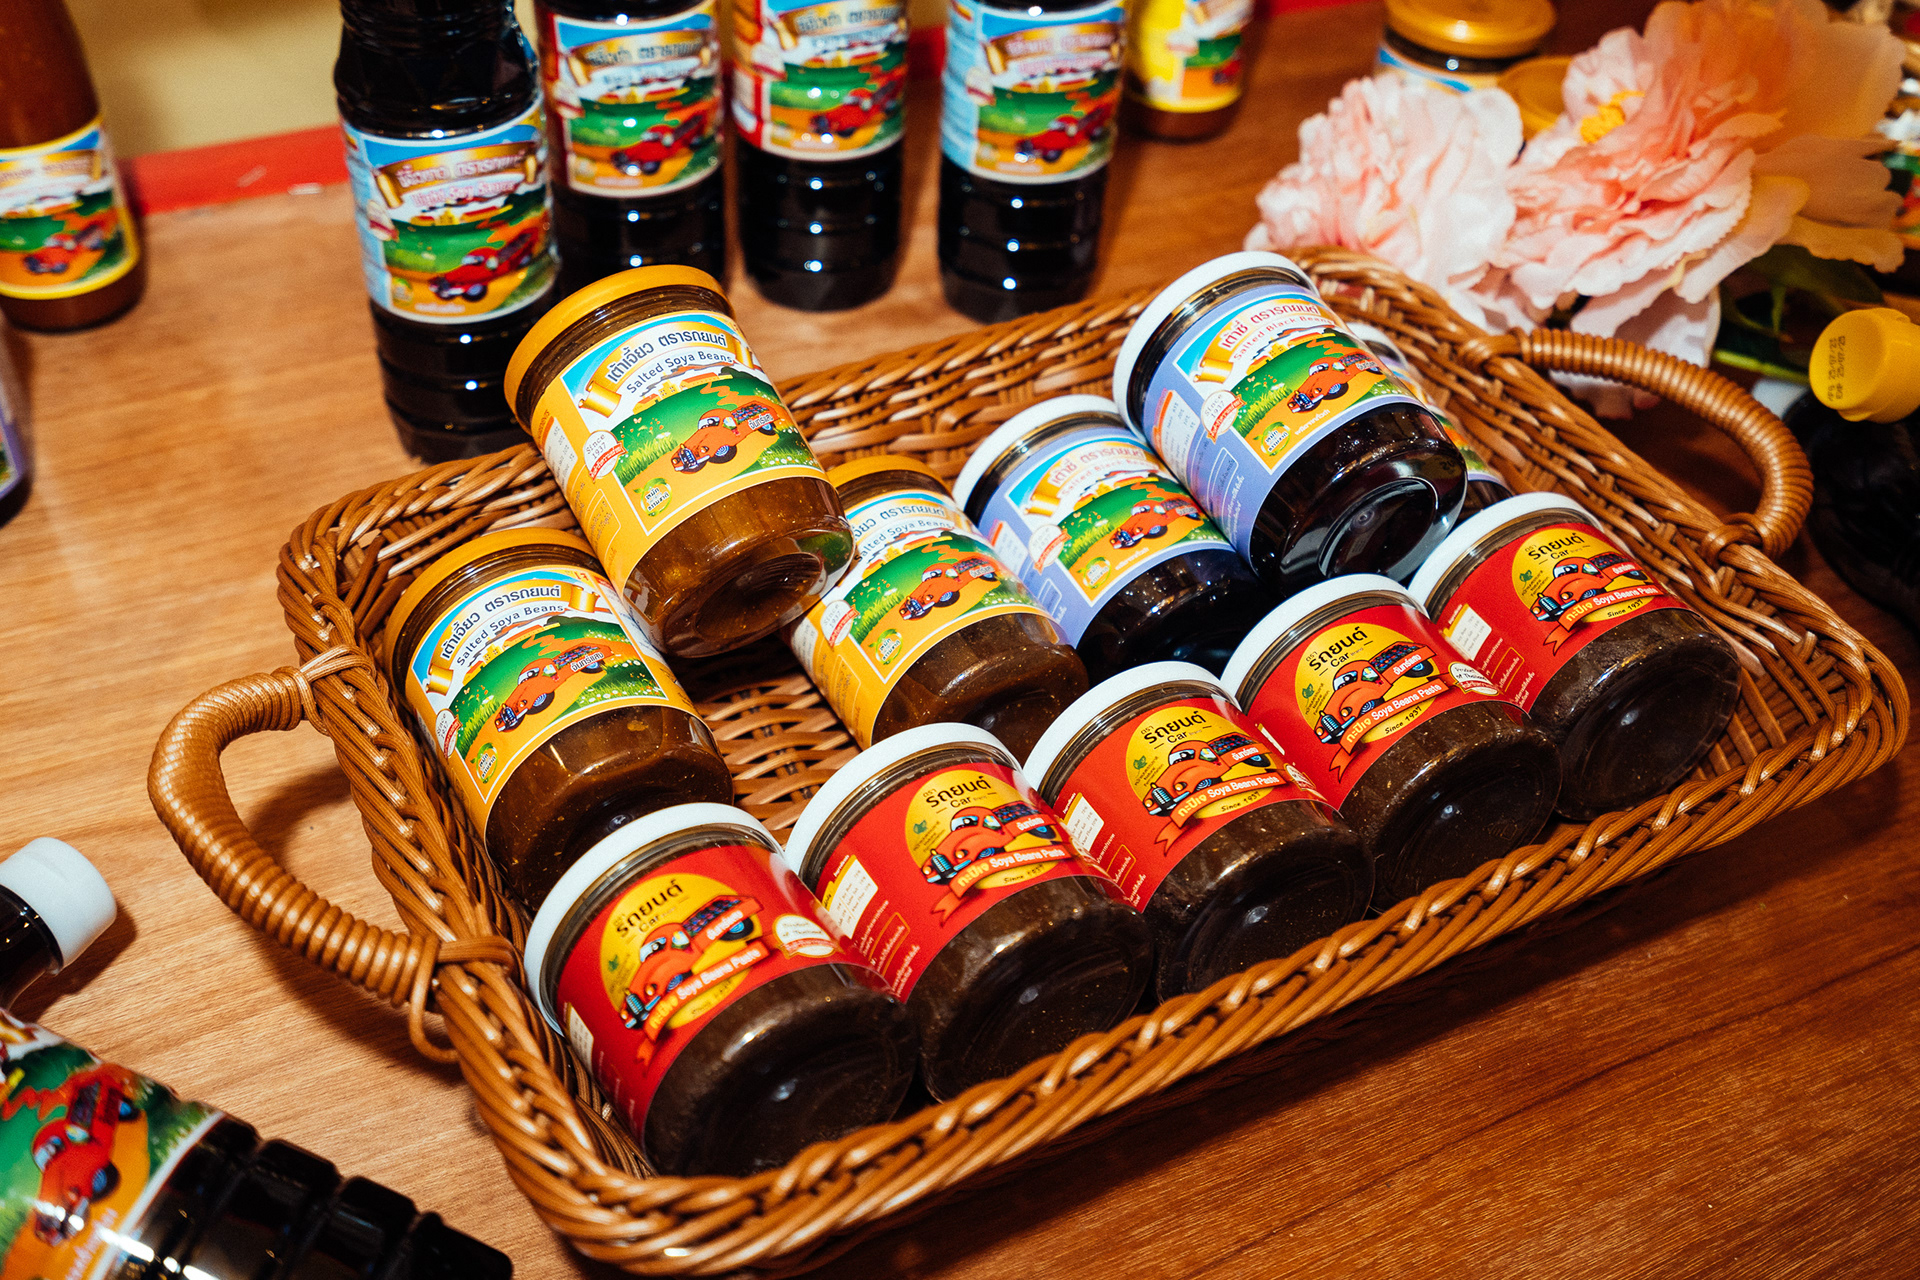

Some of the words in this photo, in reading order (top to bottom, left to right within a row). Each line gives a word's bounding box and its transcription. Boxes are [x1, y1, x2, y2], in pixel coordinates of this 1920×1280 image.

[1250, 304, 1319, 324] ตรารถยนต์
[1234, 331, 1265, 360] Salted
[1266, 318, 1295, 331] Black
[1300, 316, 1332, 325] Beans
[607, 343, 654, 382] เต้าเจี้ยว
[658, 331, 726, 347] ตรารถยนต์
[626, 363, 664, 394] Salted
[665, 353, 695, 368] Soya
[698, 351, 732, 363] Beans
[1211, 400, 1224, 418] 1937
[586, 434, 605, 455] Since
[592, 442, 606, 459] 1937
[854, 533, 887, 562] Salted
[887, 523, 915, 536] Soya
[917, 520, 952, 528] Beans
[1528, 533, 1584, 560] รถยนต์
[1551, 550, 1569, 559] Car
[1566, 602, 1593, 621] กะปิเจ
[1593, 595, 1616, 606] Soya
[1614, 590, 1639, 599] Beans
[1607, 609, 1626, 617] Since
[1627, 600, 1643, 610] 1937
[441, 612, 481, 659] เต้าเจี้ยว
[485, 586, 560, 612] ตรารถยนต์
[456, 630, 489, 666] Salted
[489, 612, 520, 631] Soya
[524, 605, 564, 616] Beans
[1306, 651, 1317, 662] ตรา
[1309, 626, 1367, 671] รถยนต์
[1331, 653, 1349, 667] Car
[1347, 718, 1371, 742] กะปิเจ
[1371, 705, 1394, 720] Soya
[1392, 694, 1419, 709] Beans
[1418, 684, 1442, 697] Paste
[1384, 722, 1403, 734] Since
[1405, 706, 1422, 721] 1937
[1141, 726, 1154, 735] ตรา
[1144, 711, 1206, 744] รถยนต์
[1167, 732, 1187, 743] Car
[926, 776, 991, 808] รถยนต์
[950, 797, 971, 808] Car
[1178, 794, 1207, 817] กะปิเจ
[1207, 786, 1231, 798] Soya
[1230, 779, 1256, 790] Beans
[1256, 776, 1279, 785] Paste
[1221, 803, 1241, 812] Since
[1244, 791, 1260, 802] 1937
[989, 857, 1015, 867] Soya
[1014, 851, 1044, 861] Beans
[1041, 849, 1065, 858] Paste
[639, 916, 659, 932] Car
[676, 980, 703, 1000] Soya
[700, 963, 734, 985] Beans
[730, 949, 761, 968] Paste
